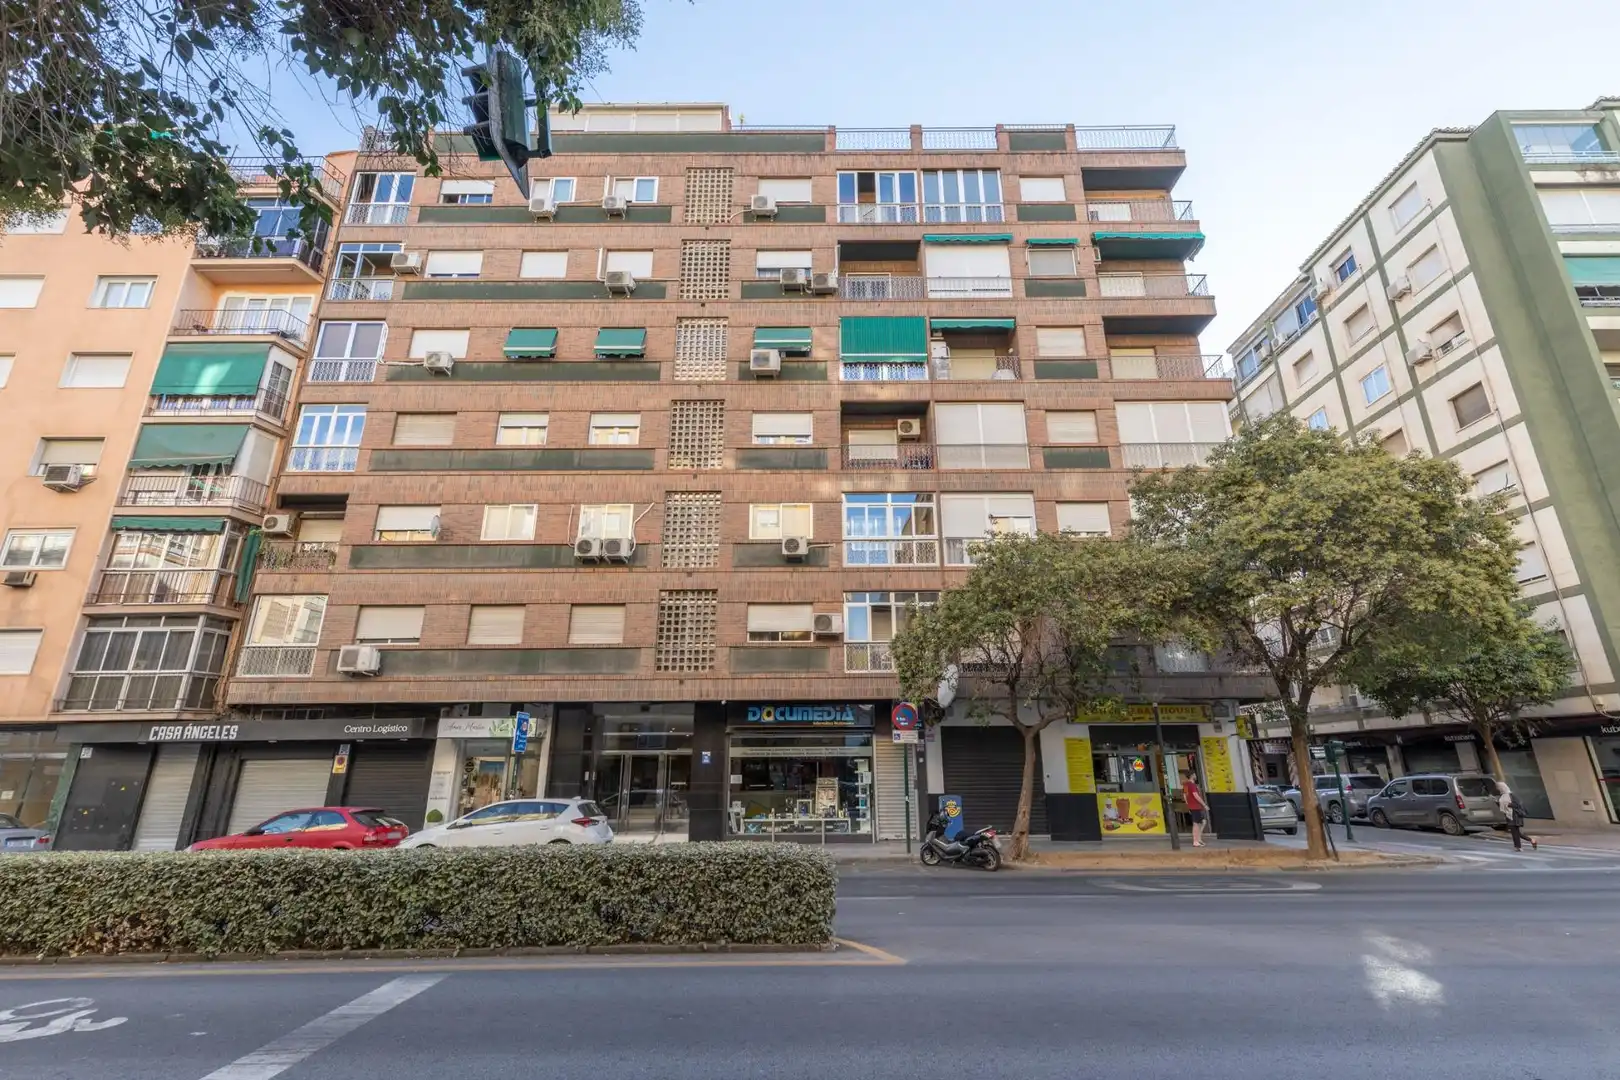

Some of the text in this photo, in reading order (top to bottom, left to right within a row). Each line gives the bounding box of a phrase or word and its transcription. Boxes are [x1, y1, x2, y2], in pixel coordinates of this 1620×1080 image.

[1160, 706, 1196, 715] HOUSE
[149, 723, 239, 741] CASA ÁNGELES
[344, 724, 408, 735] Centro Logístico
